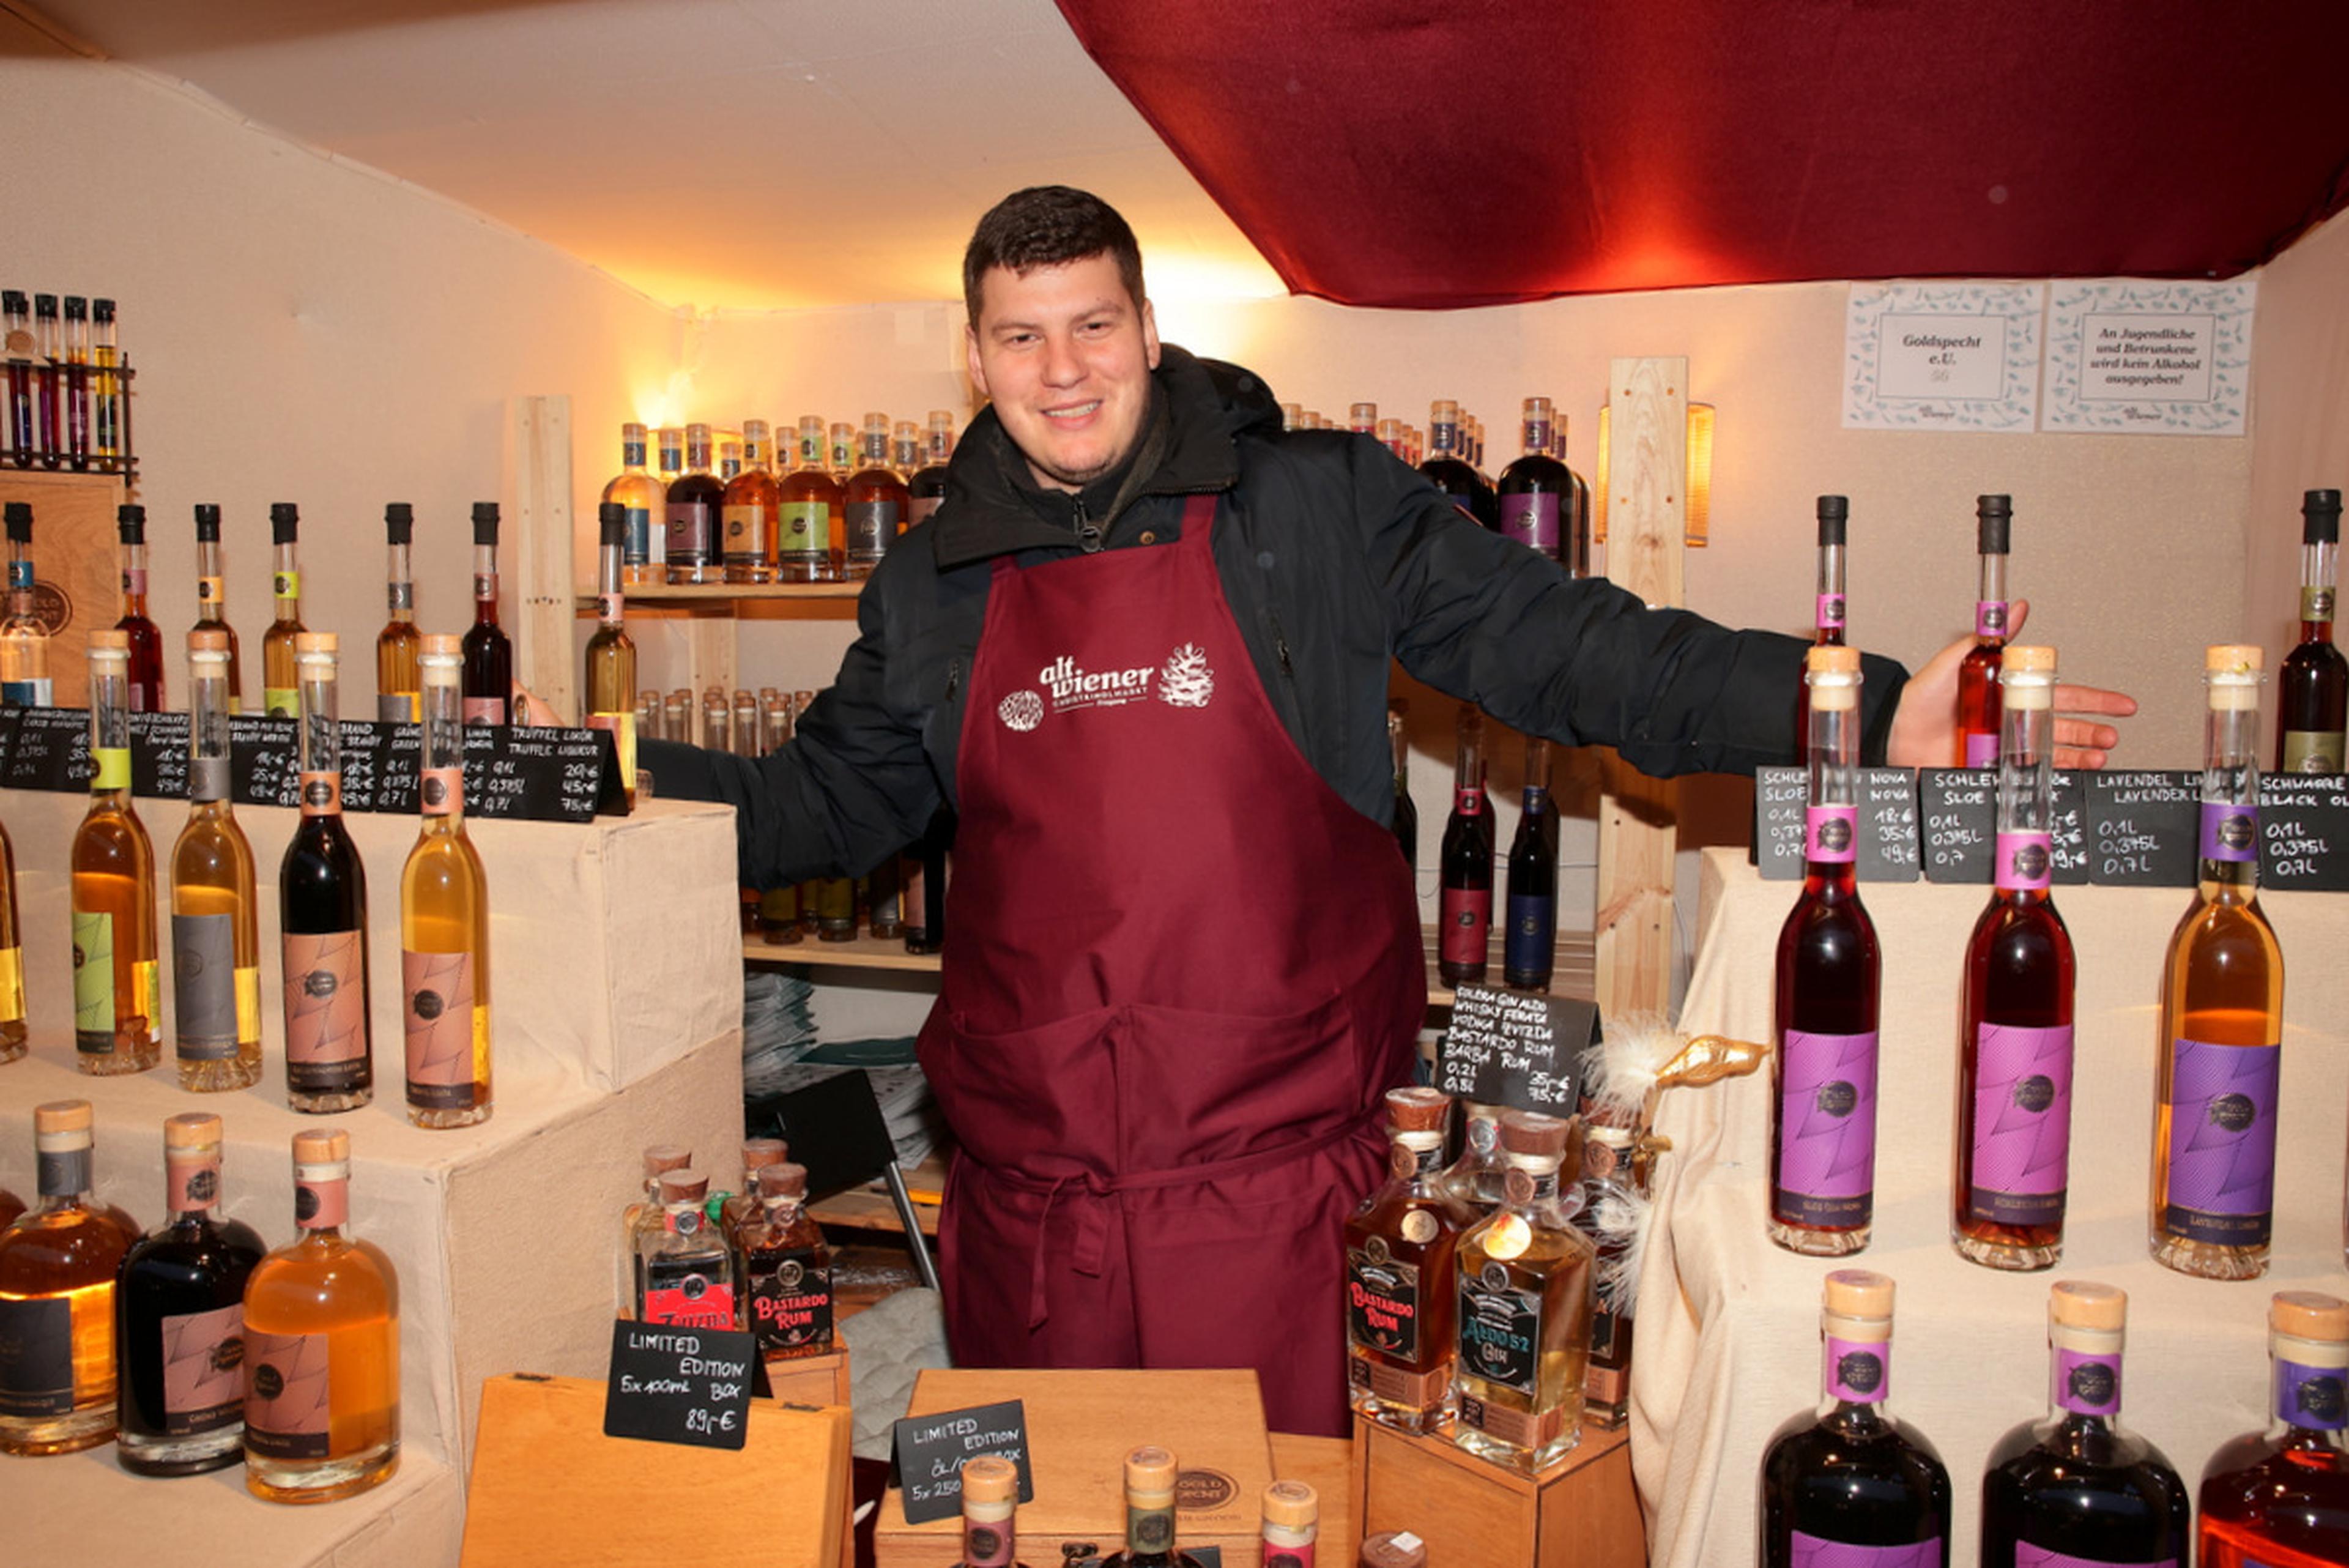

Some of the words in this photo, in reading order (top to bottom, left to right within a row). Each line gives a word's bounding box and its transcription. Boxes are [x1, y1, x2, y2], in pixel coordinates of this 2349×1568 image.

[1902, 334, 1981, 350] Goldspecht
[2099, 328, 2117, 338] An
[2121, 329, 2196, 341] Jugendliche
[2096, 343, 2121, 353] und
[2124, 344, 2197, 354] Betrunkene
[1929, 353, 1956, 365] e.U.
[2091, 358, 2120, 368] wird
[2123, 359, 2150, 368] kein
[2152, 359, 2201, 370] Alkohol
[2106, 374, 2184, 386] ausgegeben!
[1040, 656, 1074, 684] alt
[1052, 667, 1154, 698] wiener
[511, 727, 558, 741] TRÜFFEL
[563, 729, 594, 741] LIKÖR
[508, 743, 553, 756] TRUFFLE
[1870, 772, 1906, 785] NOVA
[2097, 773, 2172, 788] LAVENDEL
[1765, 787, 1806, 801] SLOE
[1870, 789, 1909, 801] NOVA
[1944, 790, 1984, 805] SLOE
[2114, 788, 2189, 803] LAVENDER
[2260, 793, 2318, 807] BLACK
[1452, 1013, 1494, 1030] VODKA
[1448, 1025, 1517, 1050] BASTARDO
[1524, 1041, 1555, 1058] RUM
[1501, 1052, 1531, 1071] RUM
[754, 1292, 828, 1320] BASTARDO
[1351, 1282, 1414, 1318] BASTARDO
[774, 1310, 813, 1330] RUM
[1365, 1307, 1398, 1332] RUM
[629, 1332, 700, 1354] LIMITED
[1482, 1342, 1508, 1364] GIN
[680, 1357, 745, 1377] EDITION
[913, 1418, 978, 1444] LIMITED
[964, 1430, 1019, 1450] EDITION
